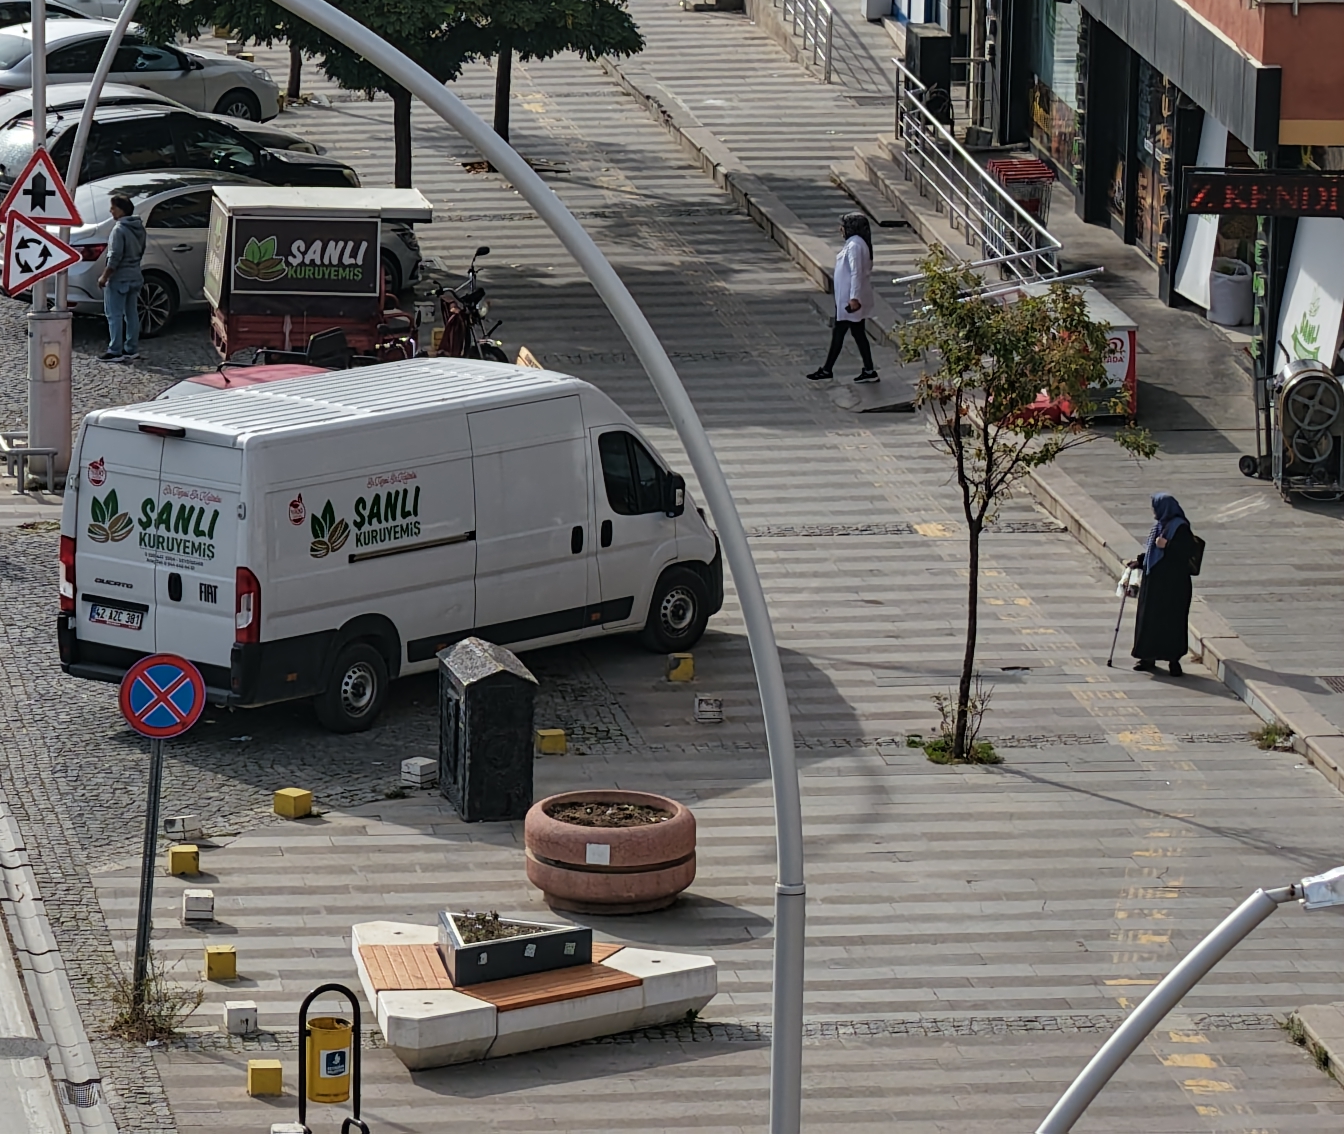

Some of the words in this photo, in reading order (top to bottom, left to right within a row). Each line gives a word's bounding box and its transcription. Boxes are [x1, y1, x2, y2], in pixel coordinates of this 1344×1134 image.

[288, 239, 368, 266] ŞANLI
[288, 265, 362, 282] KURUYEMİŞ
[137, 498, 220, 540] ŞANLI
[353, 485, 421, 531] ŞANLI
[139, 531, 216, 561] KURUYEMİŞ
[355, 520, 421, 548] KURUYEMİŞ
[199, 582, 219, 605] FIAT
